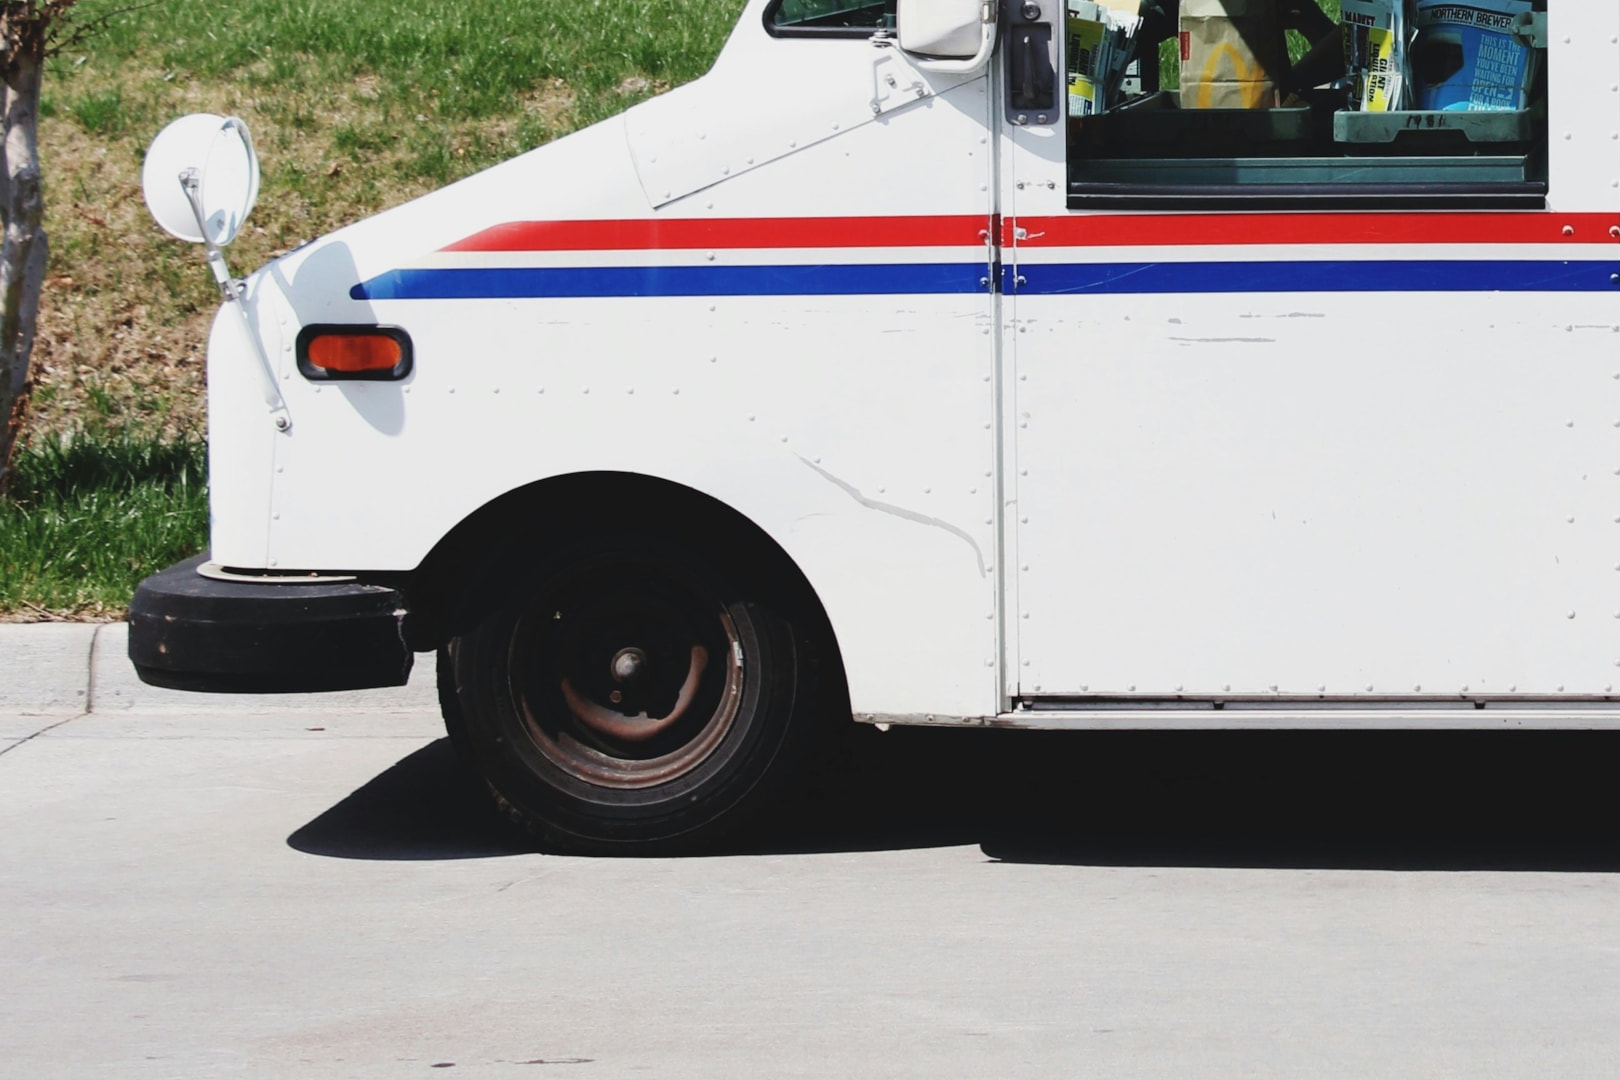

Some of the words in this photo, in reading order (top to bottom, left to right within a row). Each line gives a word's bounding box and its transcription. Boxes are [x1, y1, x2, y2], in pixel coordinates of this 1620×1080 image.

[1431, 7, 1474, 21] NORTHERN
[1476, 12, 1512, 29] BREWER
[1481, 34, 1497, 47] THIS
[1498, 38, 1507, 48] IS
[1478, 44, 1520, 65] MOMENT
[1474, 68, 1501, 83] WAITING
[1502, 75, 1515, 87] FOR
[1471, 78, 1497, 97] OPEN
